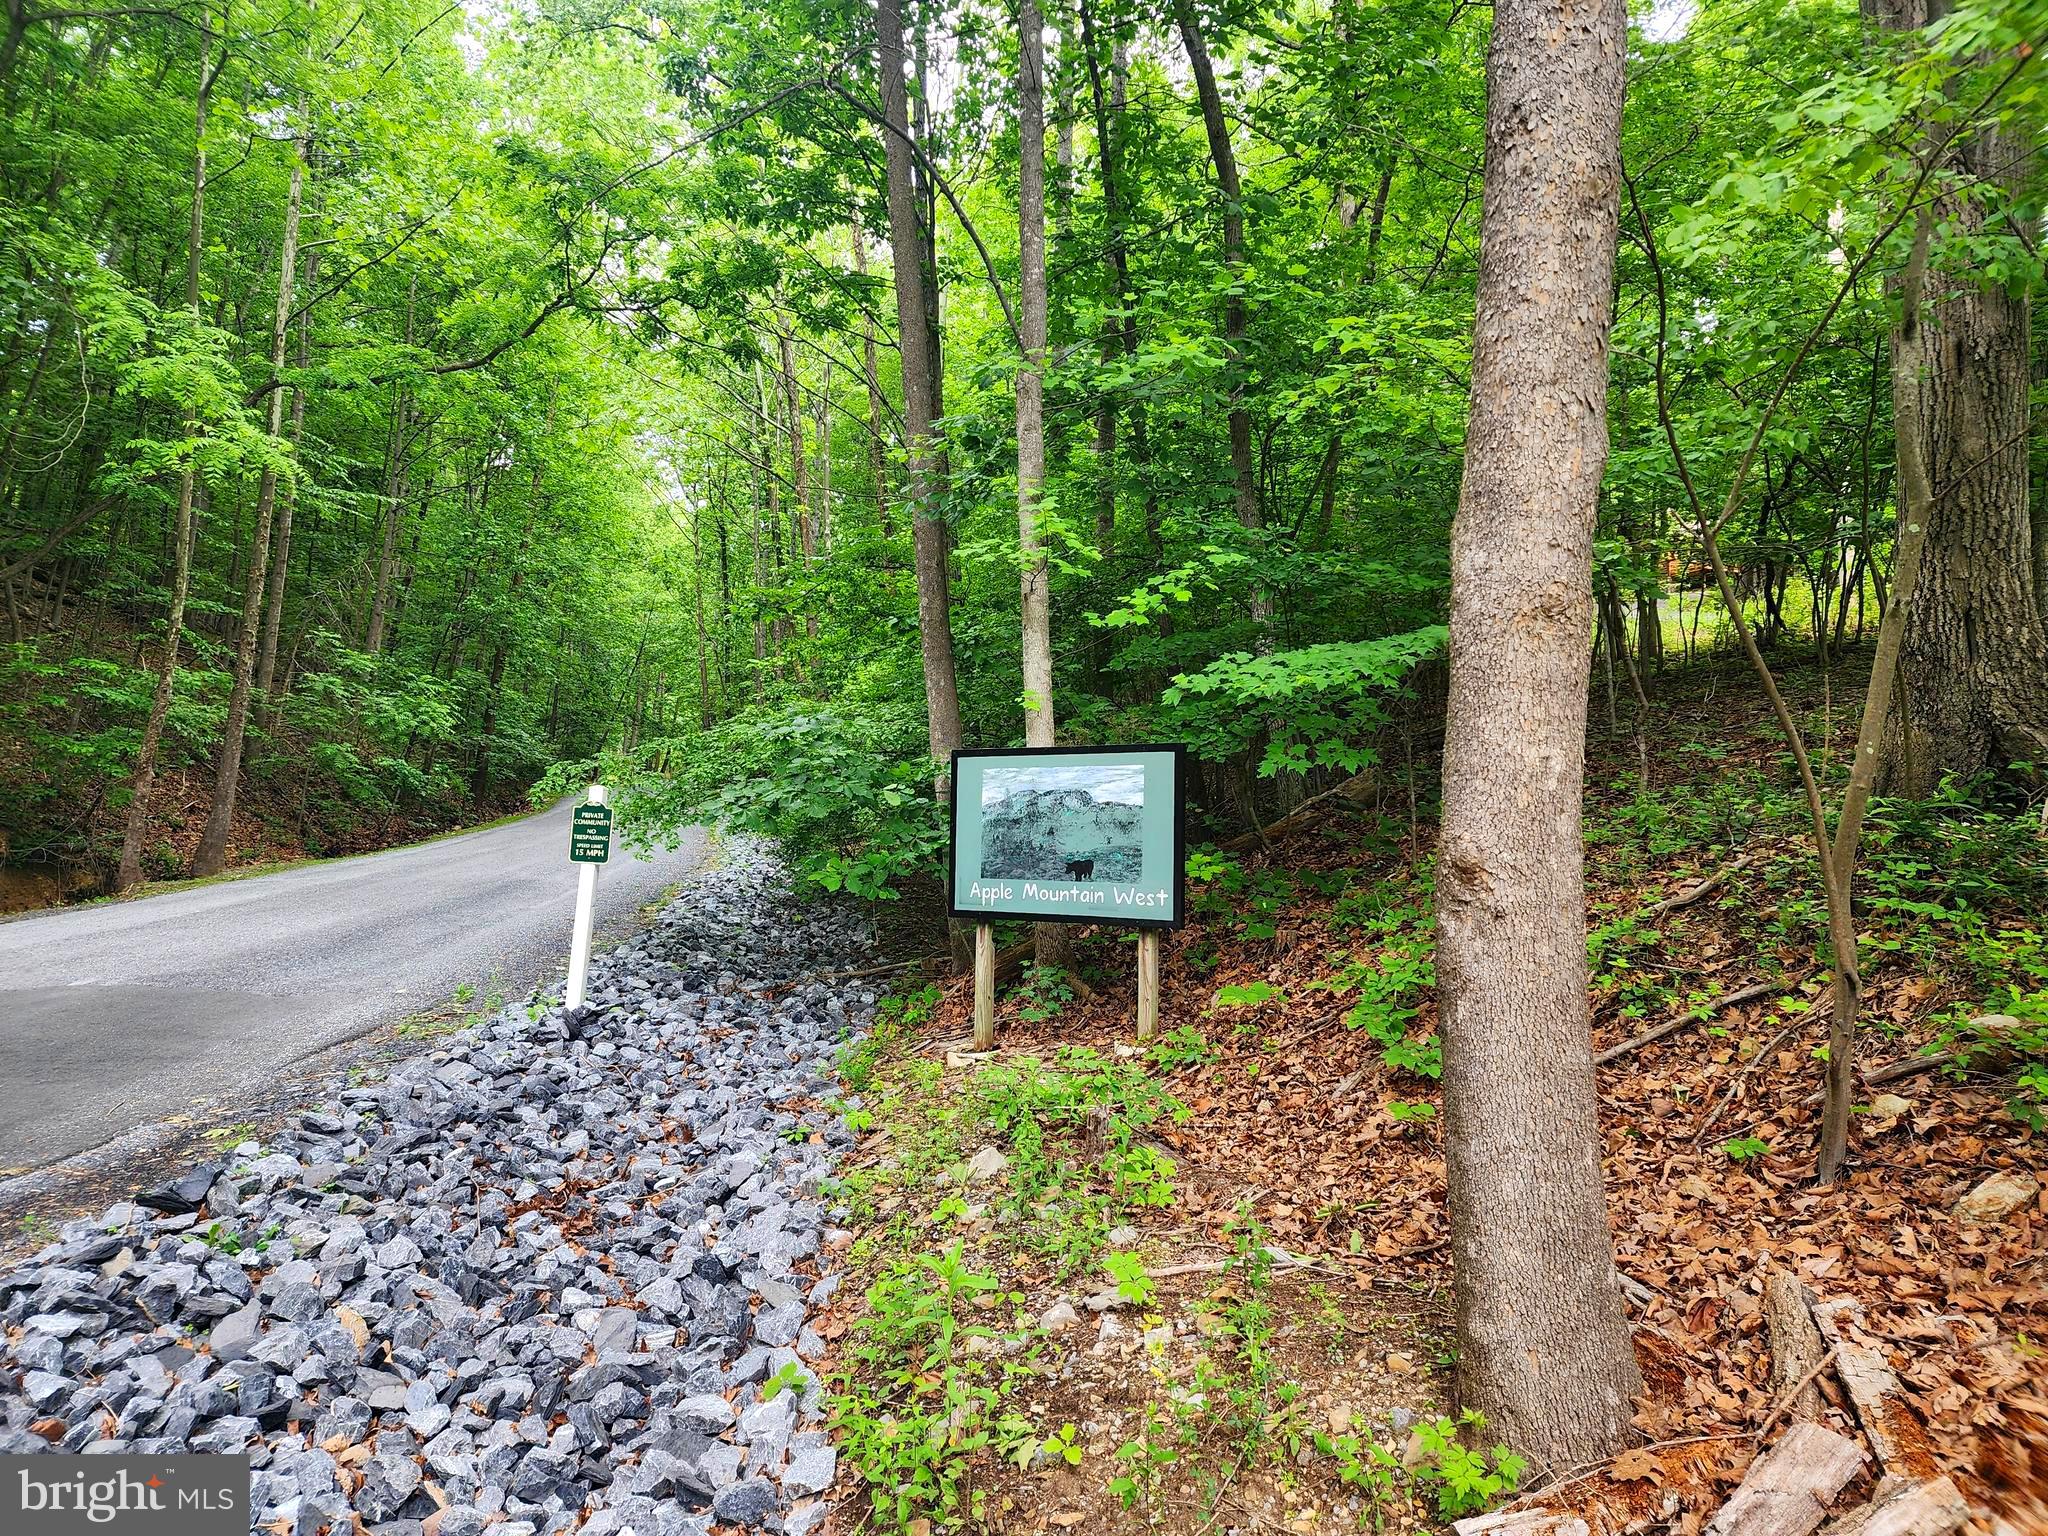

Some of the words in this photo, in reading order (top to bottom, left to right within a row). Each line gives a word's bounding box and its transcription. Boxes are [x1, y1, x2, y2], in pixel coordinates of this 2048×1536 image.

[586, 849, 604, 857] MPH
[969, 882, 1013, 907] Apple
[1022, 882, 1104, 904] Mountain
[1113, 887, 1169, 907] West
